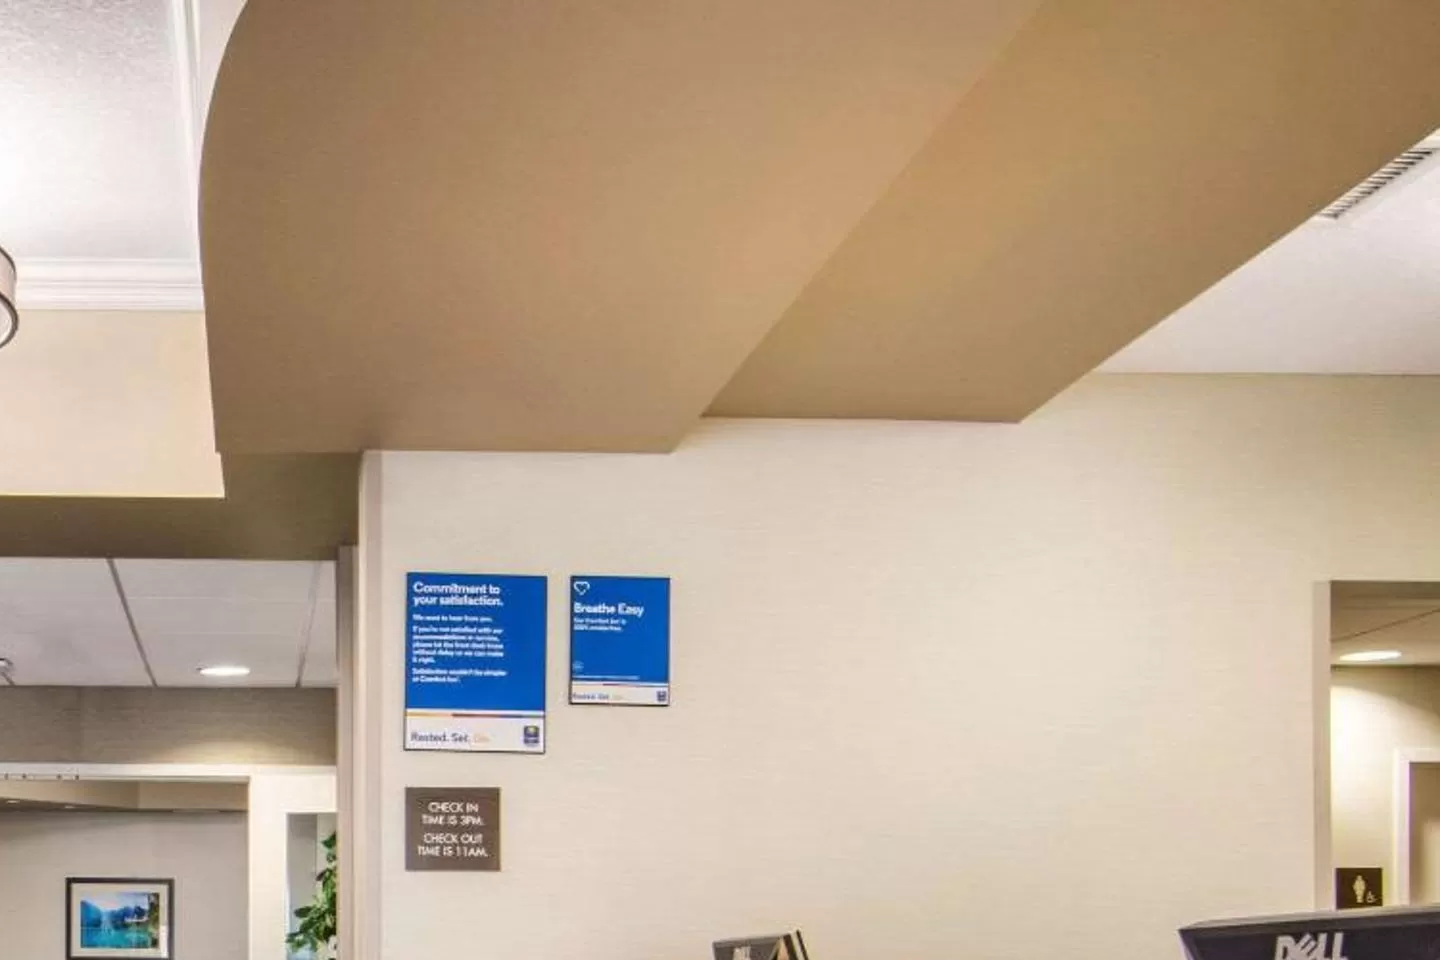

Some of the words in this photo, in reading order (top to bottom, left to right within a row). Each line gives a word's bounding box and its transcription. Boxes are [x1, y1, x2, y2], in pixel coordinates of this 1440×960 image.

[413, 581, 487, 594] Commitment
[489, 584, 501, 594] to
[413, 596, 438, 607] your
[440, 595, 504, 606] satisfaction.
[573, 602, 616, 614] Breathe
[618, 603, 645, 618] Easy
[411, 731, 450, 742] Rested.
[427, 801, 464, 813] CHECK
[466, 802, 479, 813] IN
[422, 814, 445, 824] TIME
[447, 815, 458, 825] IS
[423, 832, 459, 844] CHECK
[460, 833, 483, 844] OUT
[417, 845, 440, 856] TIME
[443, 846, 453, 856] IS
